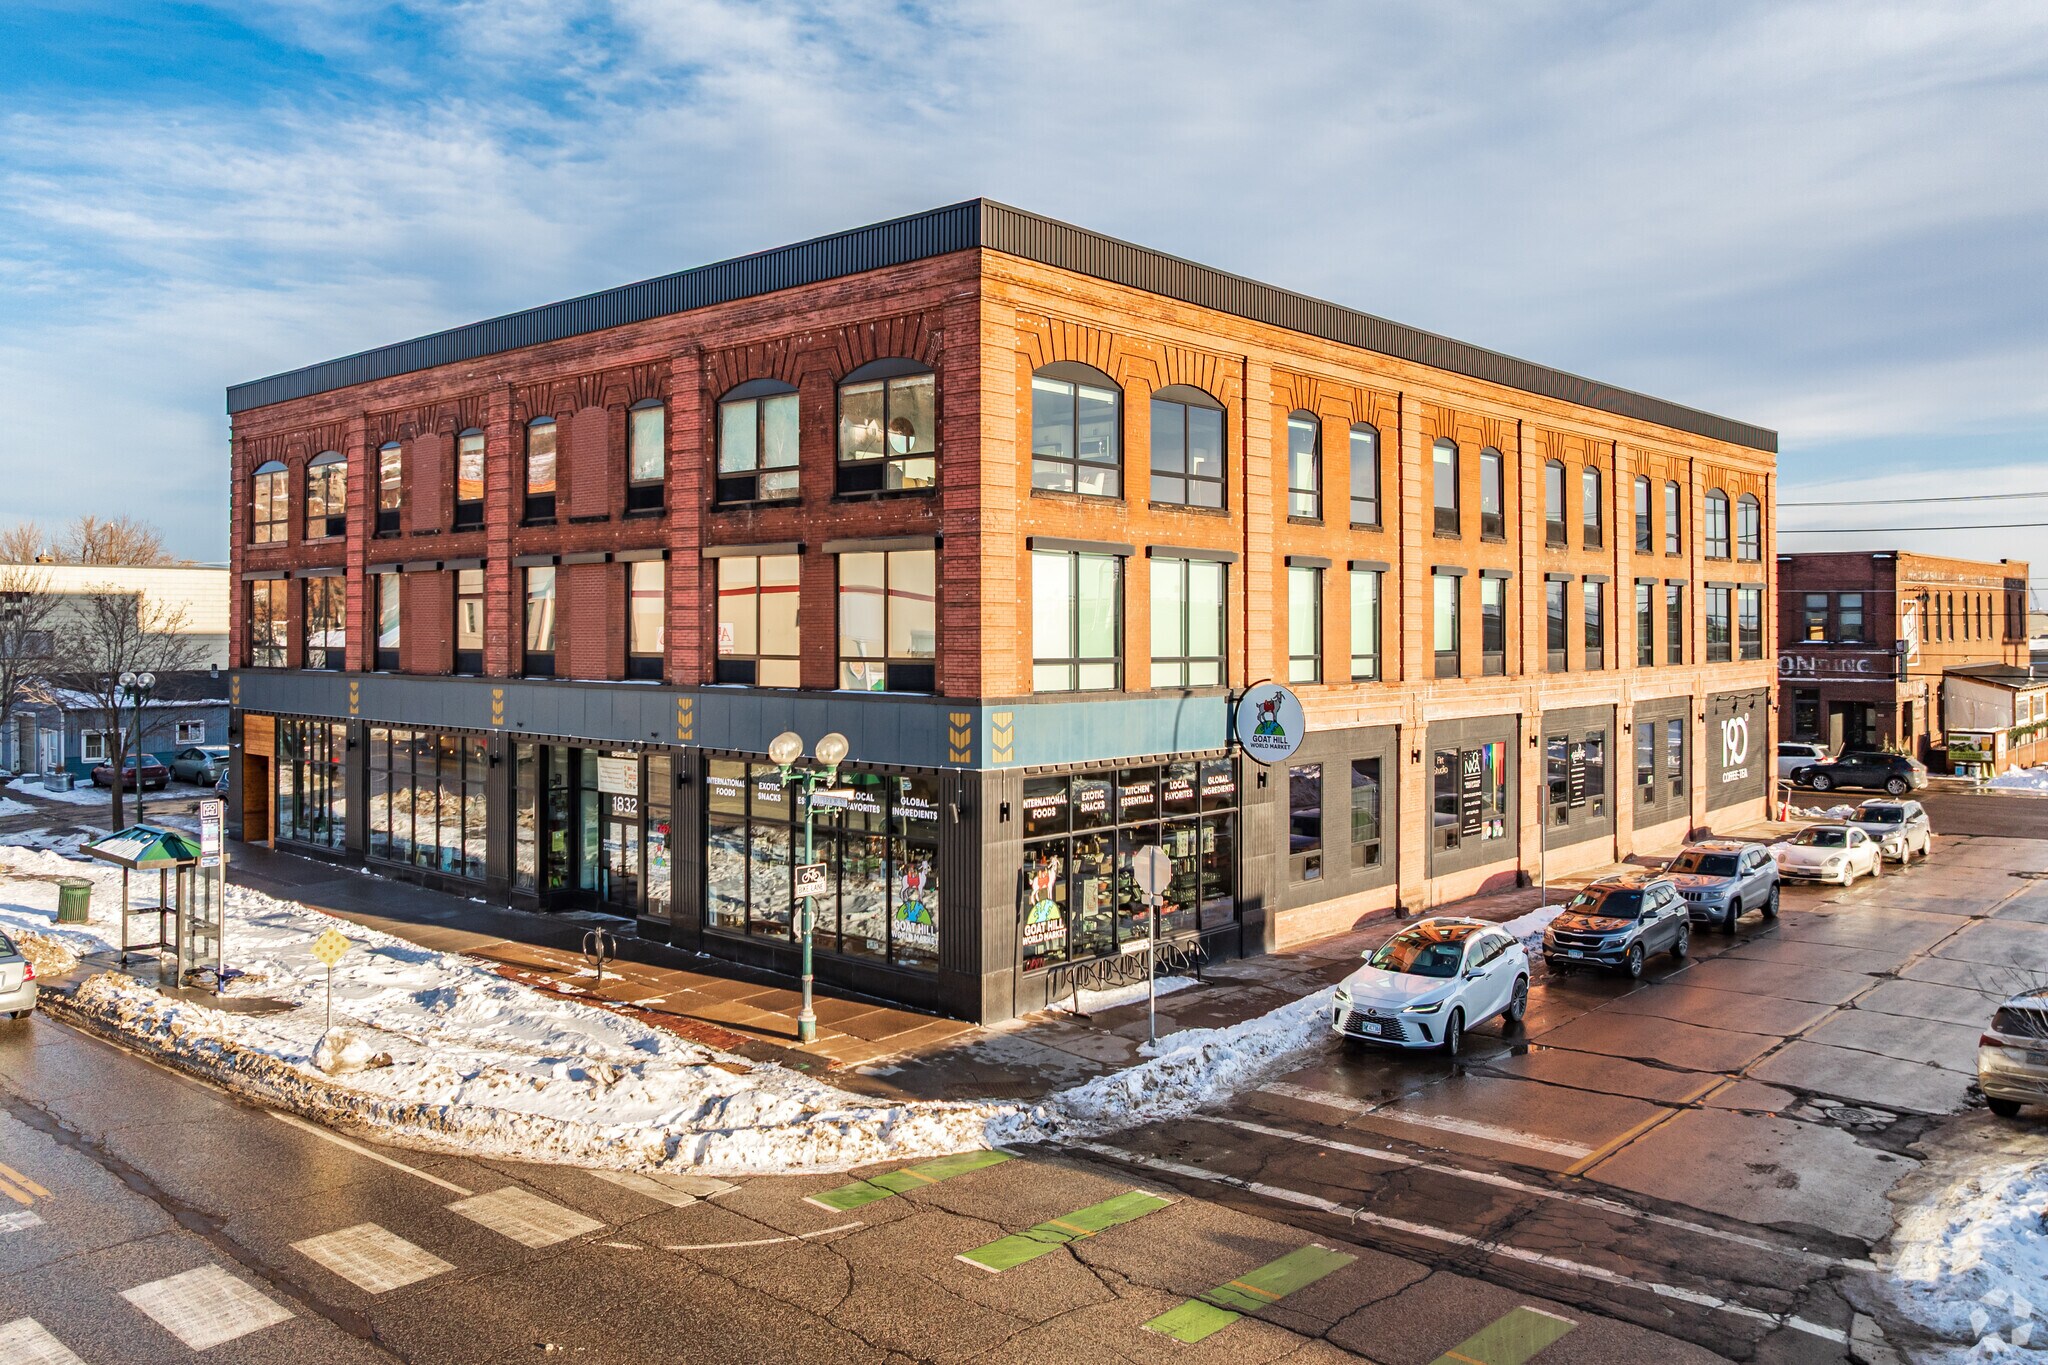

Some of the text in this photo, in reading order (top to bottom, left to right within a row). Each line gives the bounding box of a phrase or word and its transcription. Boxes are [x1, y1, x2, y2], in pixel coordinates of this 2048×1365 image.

[1252, 735, 1288, 744] GOAT HILL
[706, 776, 745, 788] INTERNATIONAL
[1169, 780, 1189, 790] LOCAL
[1207, 775, 1230, 785] GLOBAL
[716, 787, 736, 797] FOODS
[758, 782, 781, 792] EXOTIC
[1125, 784, 1151, 796] KITCHEN
[1201, 783, 1235, 796] INGREDIENTS
[757, 792, 782, 802] SNACKS
[853, 791, 875, 802] OCAL
[1081, 789, 1105, 802] EXOTIC
[1120, 794, 1154, 807] ESSENTIALS
[1164, 789, 1194, 801] FAVORITES
[612, 796, 638, 813] 1832
[900, 796, 930, 808] GLOBAL
[1023, 794, 1068, 809] NTERNATIONAL
[1081, 800, 1106, 813] SNACKS
[892, 806, 938, 820] INGREDIENTS
[1033, 806, 1057, 819] FOODS
[798, 882, 824, 894] BIKE LANE
[894, 919, 936, 936] GOAT HILL
[1024, 917, 1065, 937] GOAT HILL
[891, 930, 939, 945] WORLD MARKET
[1022, 928, 1067, 946] WORLD MARKET
